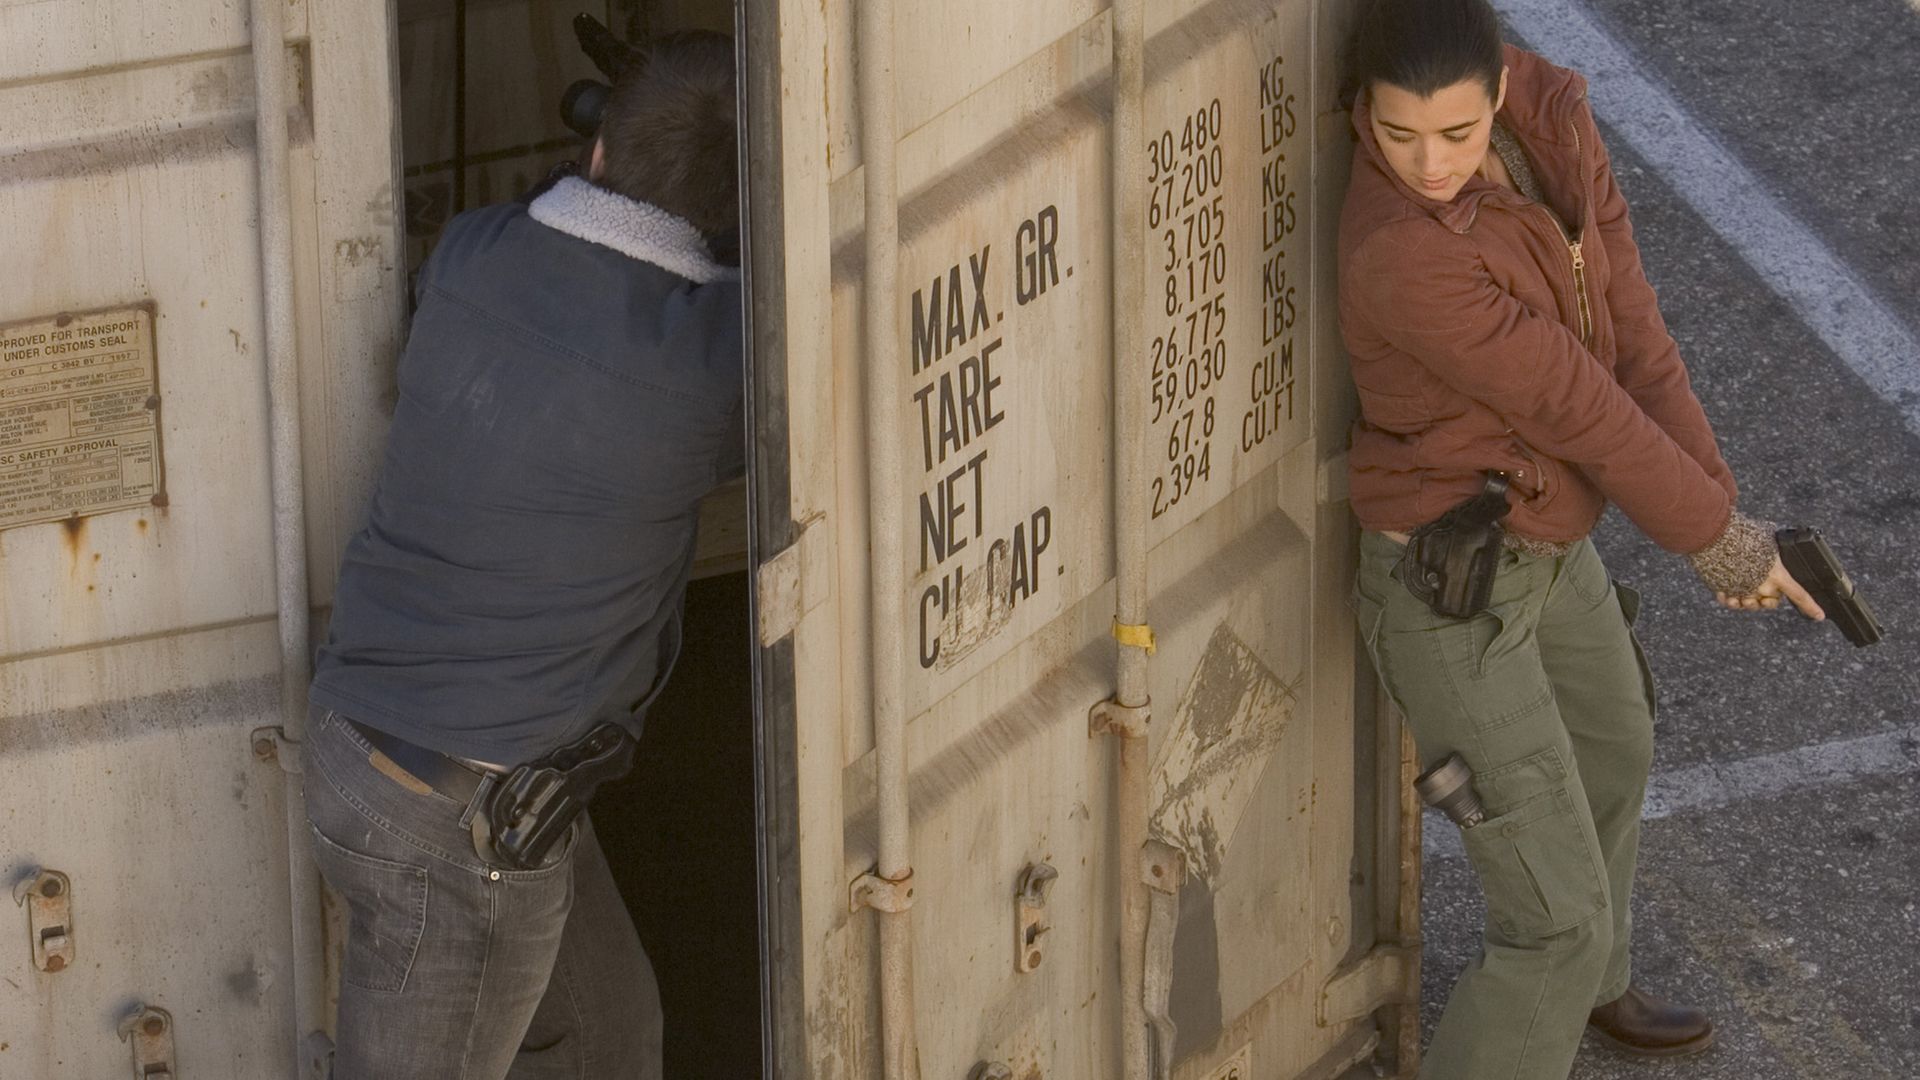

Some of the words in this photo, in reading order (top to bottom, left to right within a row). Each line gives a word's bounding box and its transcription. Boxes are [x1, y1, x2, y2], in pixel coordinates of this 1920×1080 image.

[1148, 98, 1221, 183] 30,480
[1260, 56, 1284, 109] KG
[1150, 145, 1222, 229] 67,200
[1260, 94, 1296, 154] LBS
[1164, 195, 1224, 272] 3,705
[1262, 154, 1286, 207] KG
[1166, 242, 1226, 317] 8,170
[1263, 192, 1296, 252] LBS
[4, 348, 40, 362] UNDER
[45, 339, 96, 355] CUSTOMS
[100, 335, 128, 348] SEAL
[51, 330, 73, 342] FOR
[76, 320, 140, 338] TRANSPORT
[912, 244, 1004, 376] MAX.
[1016, 205, 1073, 306] GR.
[1152, 292, 1226, 380] 26,775
[1263, 251, 1286, 303] KG
[913, 337, 1005, 472] TARE
[1152, 339, 1226, 424] 59,030
[1263, 287, 1296, 347] LBS
[19, 448, 58, 462] SAFETY
[63, 440, 119, 455] APPROVAL
[1152, 441, 1211, 520] 2,394
[1168, 396, 1215, 461] 67.8
[920, 450, 987, 574] NET
